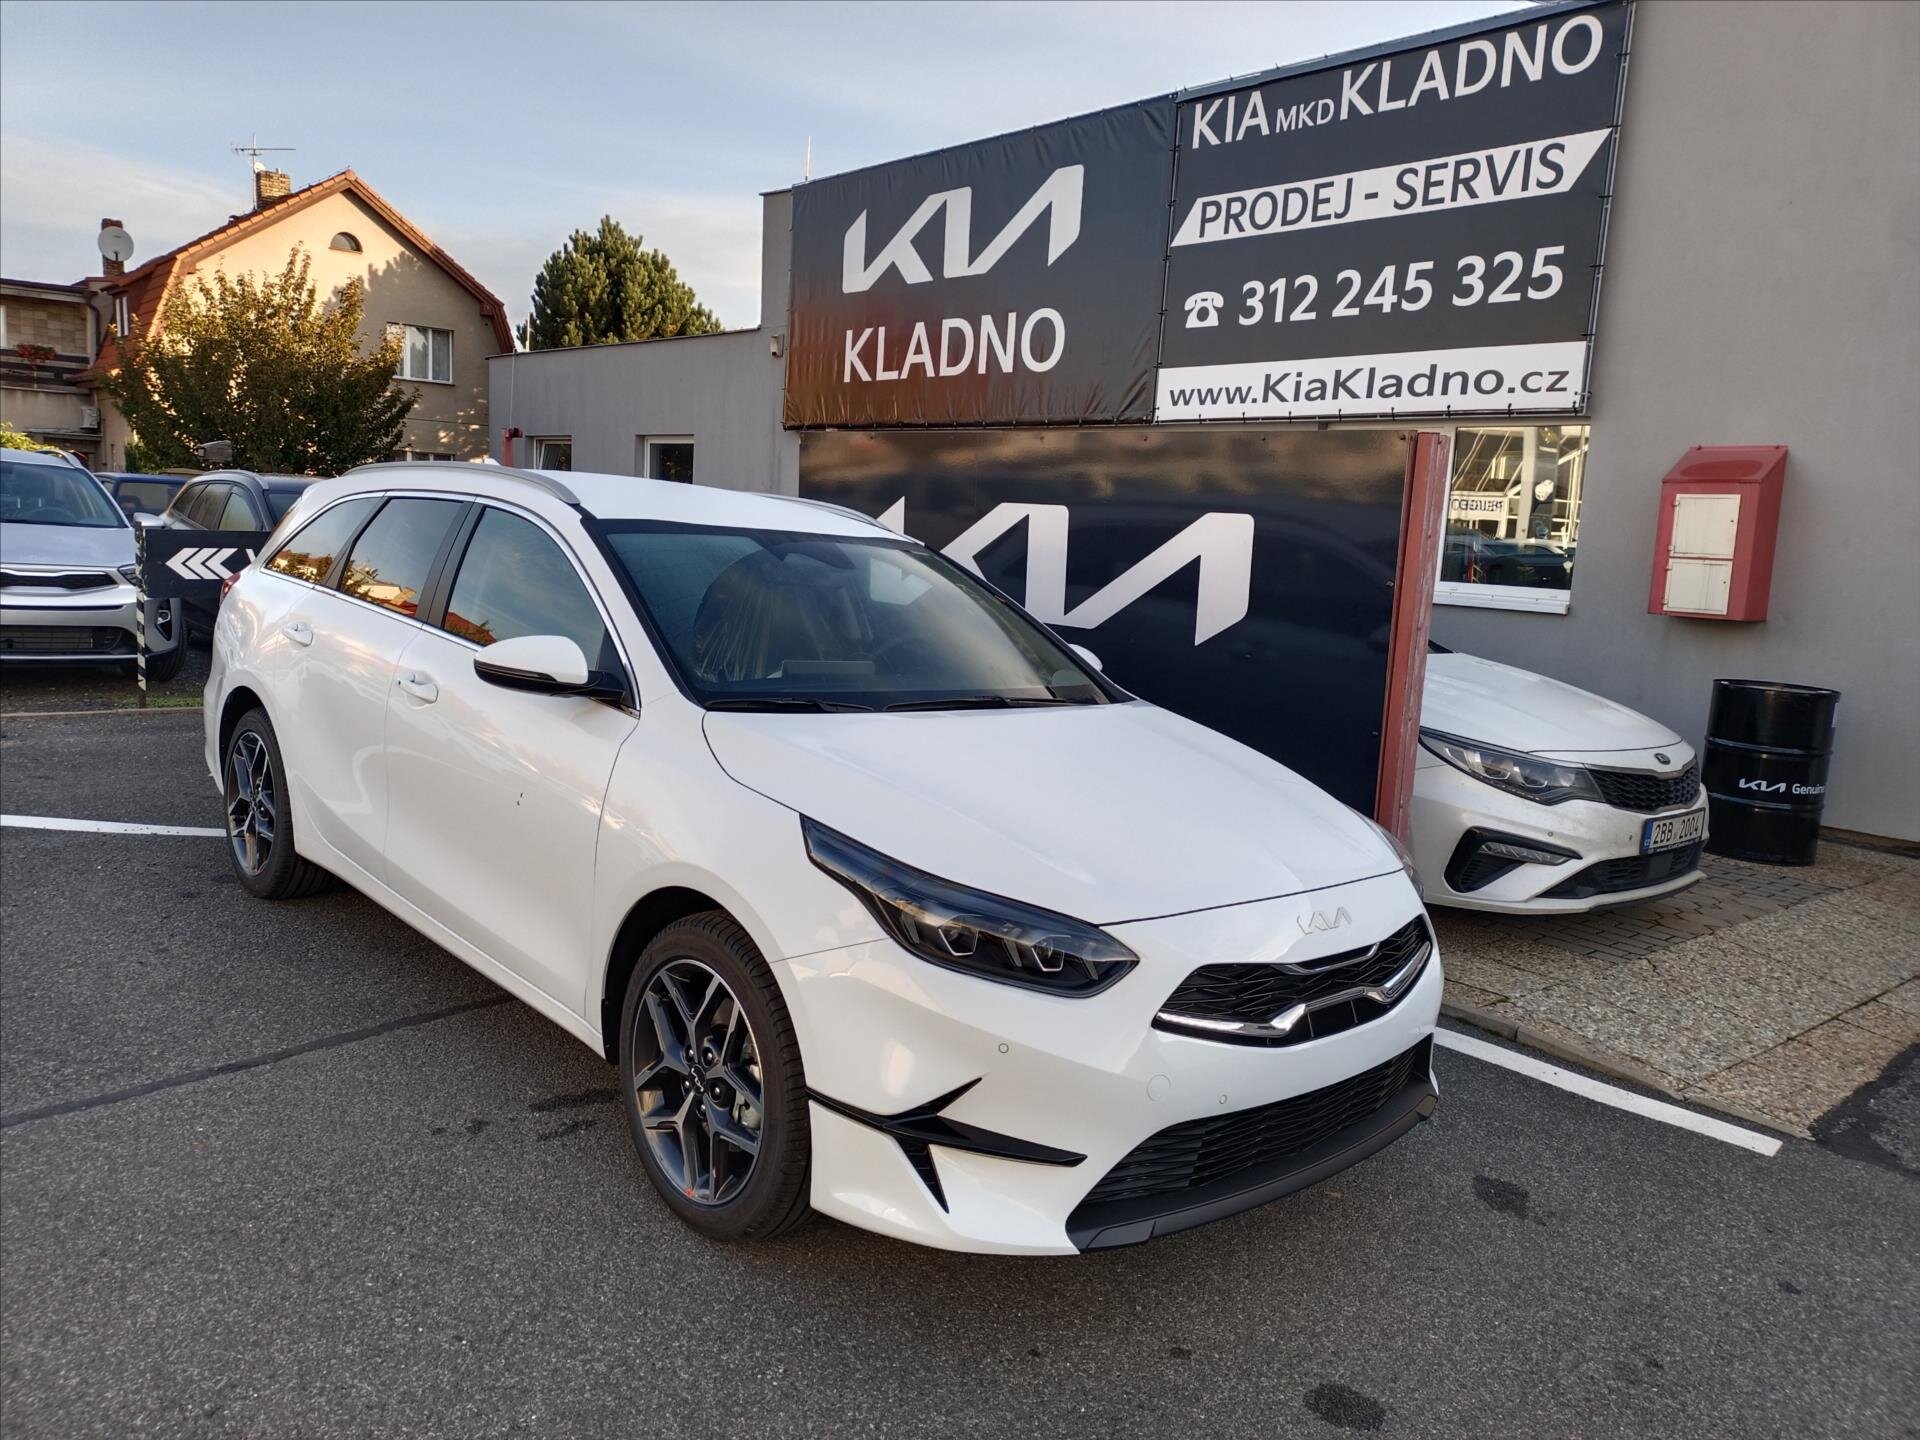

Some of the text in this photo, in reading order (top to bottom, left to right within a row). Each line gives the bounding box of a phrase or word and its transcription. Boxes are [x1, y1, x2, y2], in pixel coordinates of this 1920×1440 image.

[1192, 15, 1603, 149] KIA MKD KLADNO
[842, 164, 1085, 294] KIA
[1198, 177, 1354, 240] PRODEJ
[1392, 142, 1566, 211] SERVIS
[1238, 245, 1565, 327] 312 245 325
[843, 307, 1066, 383] KLADNO
[1169, 364, 1570, 407] www.KiaKladno.cz
